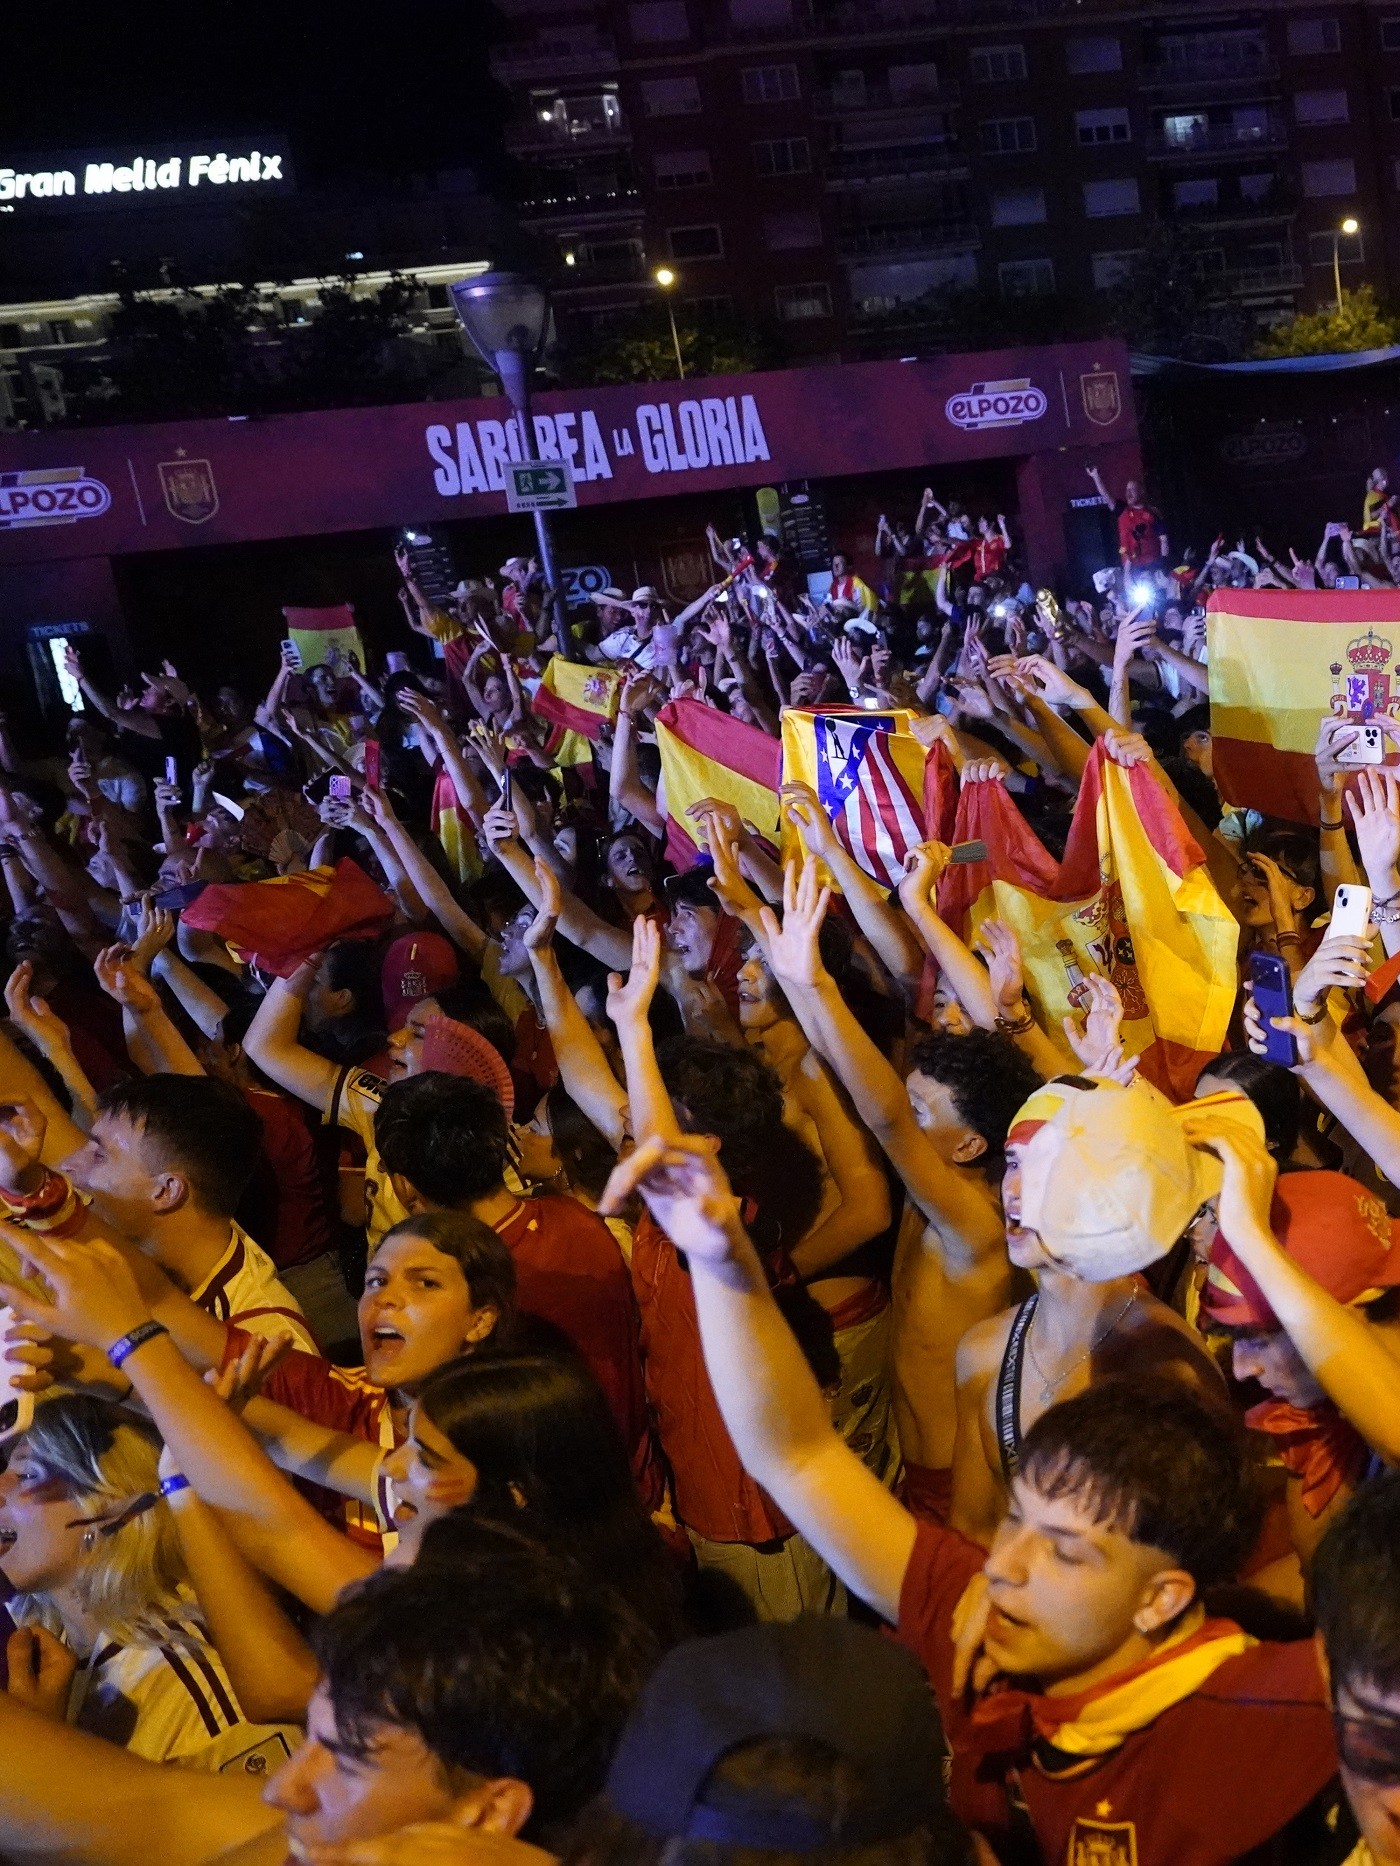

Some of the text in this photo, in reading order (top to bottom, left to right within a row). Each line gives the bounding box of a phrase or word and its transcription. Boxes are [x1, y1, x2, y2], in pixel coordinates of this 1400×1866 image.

[0, 168, 76, 200] Gran
[189, 151, 283, 187] Fénix
[612, 426, 635, 456] LA
[635, 394, 771, 474] GLORIA
